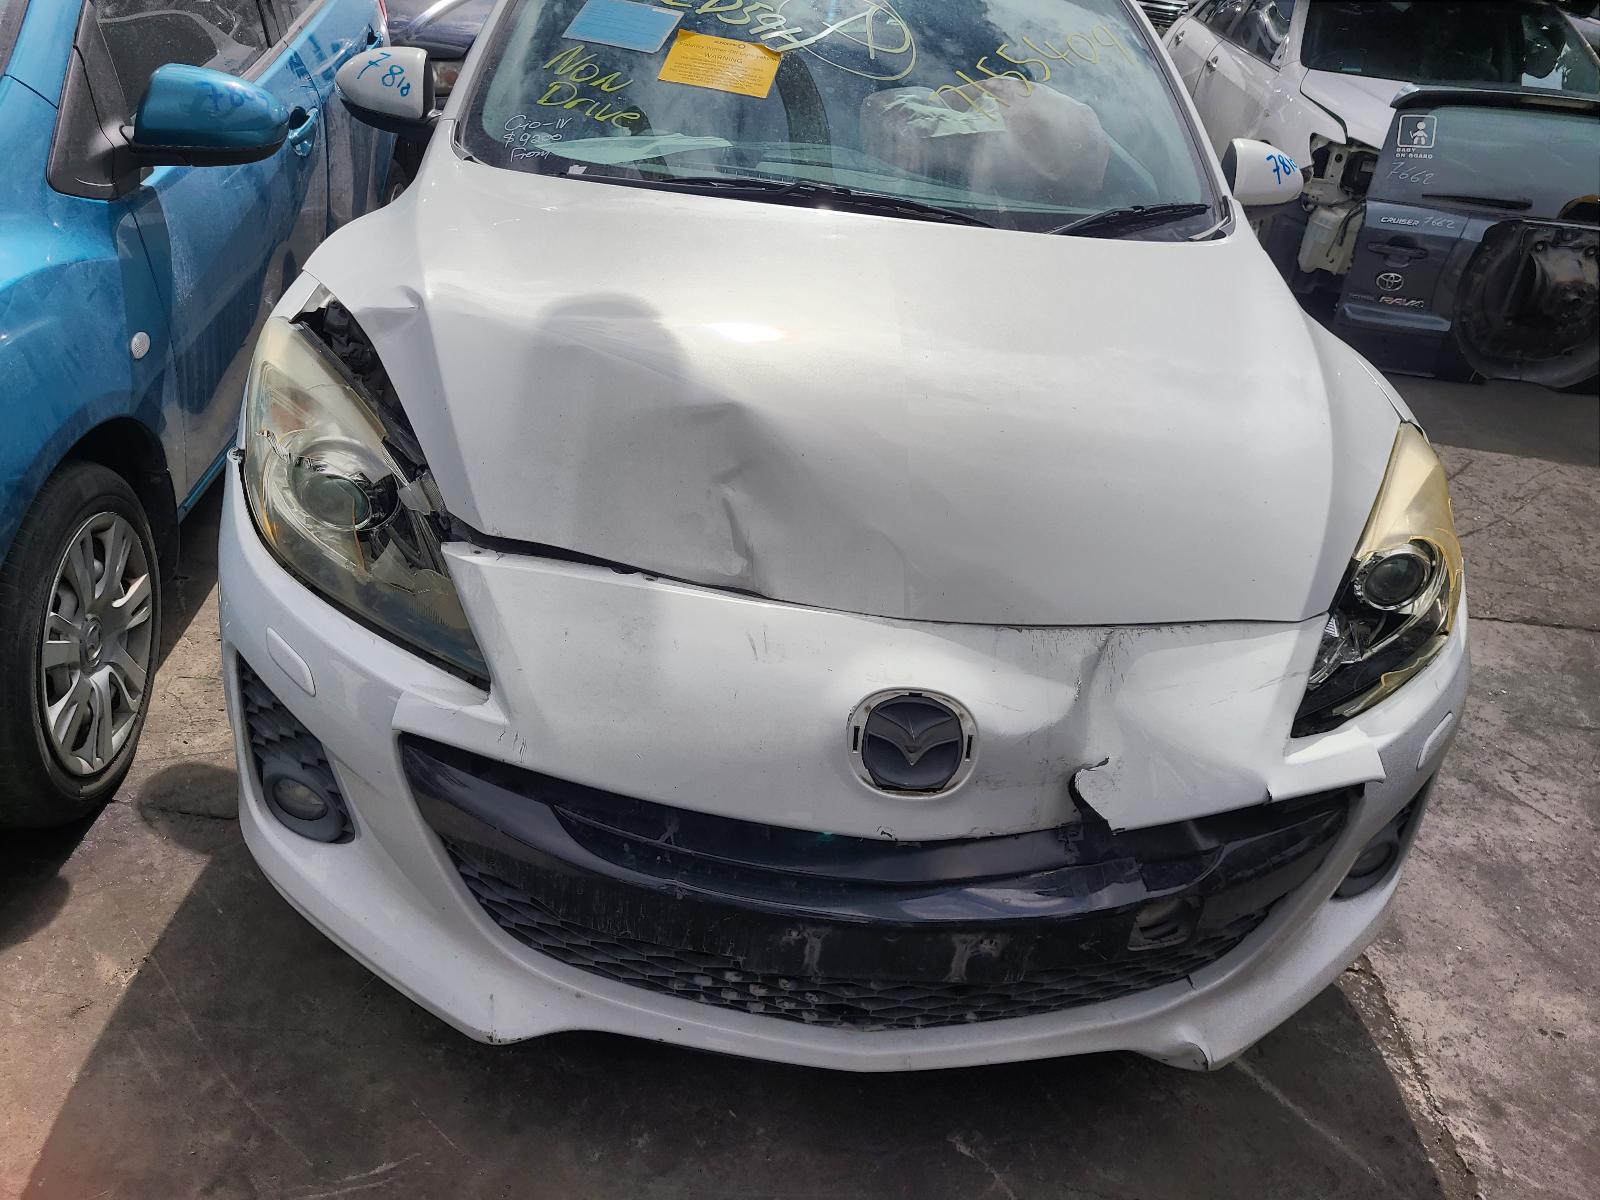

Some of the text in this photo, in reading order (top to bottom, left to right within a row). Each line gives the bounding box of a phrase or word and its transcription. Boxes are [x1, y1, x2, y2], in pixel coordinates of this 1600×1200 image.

[704, 52, 743, 64] WARNING
[1387, 161, 1435, 186] 7662
[1380, 216, 1420, 227] CRUISER
